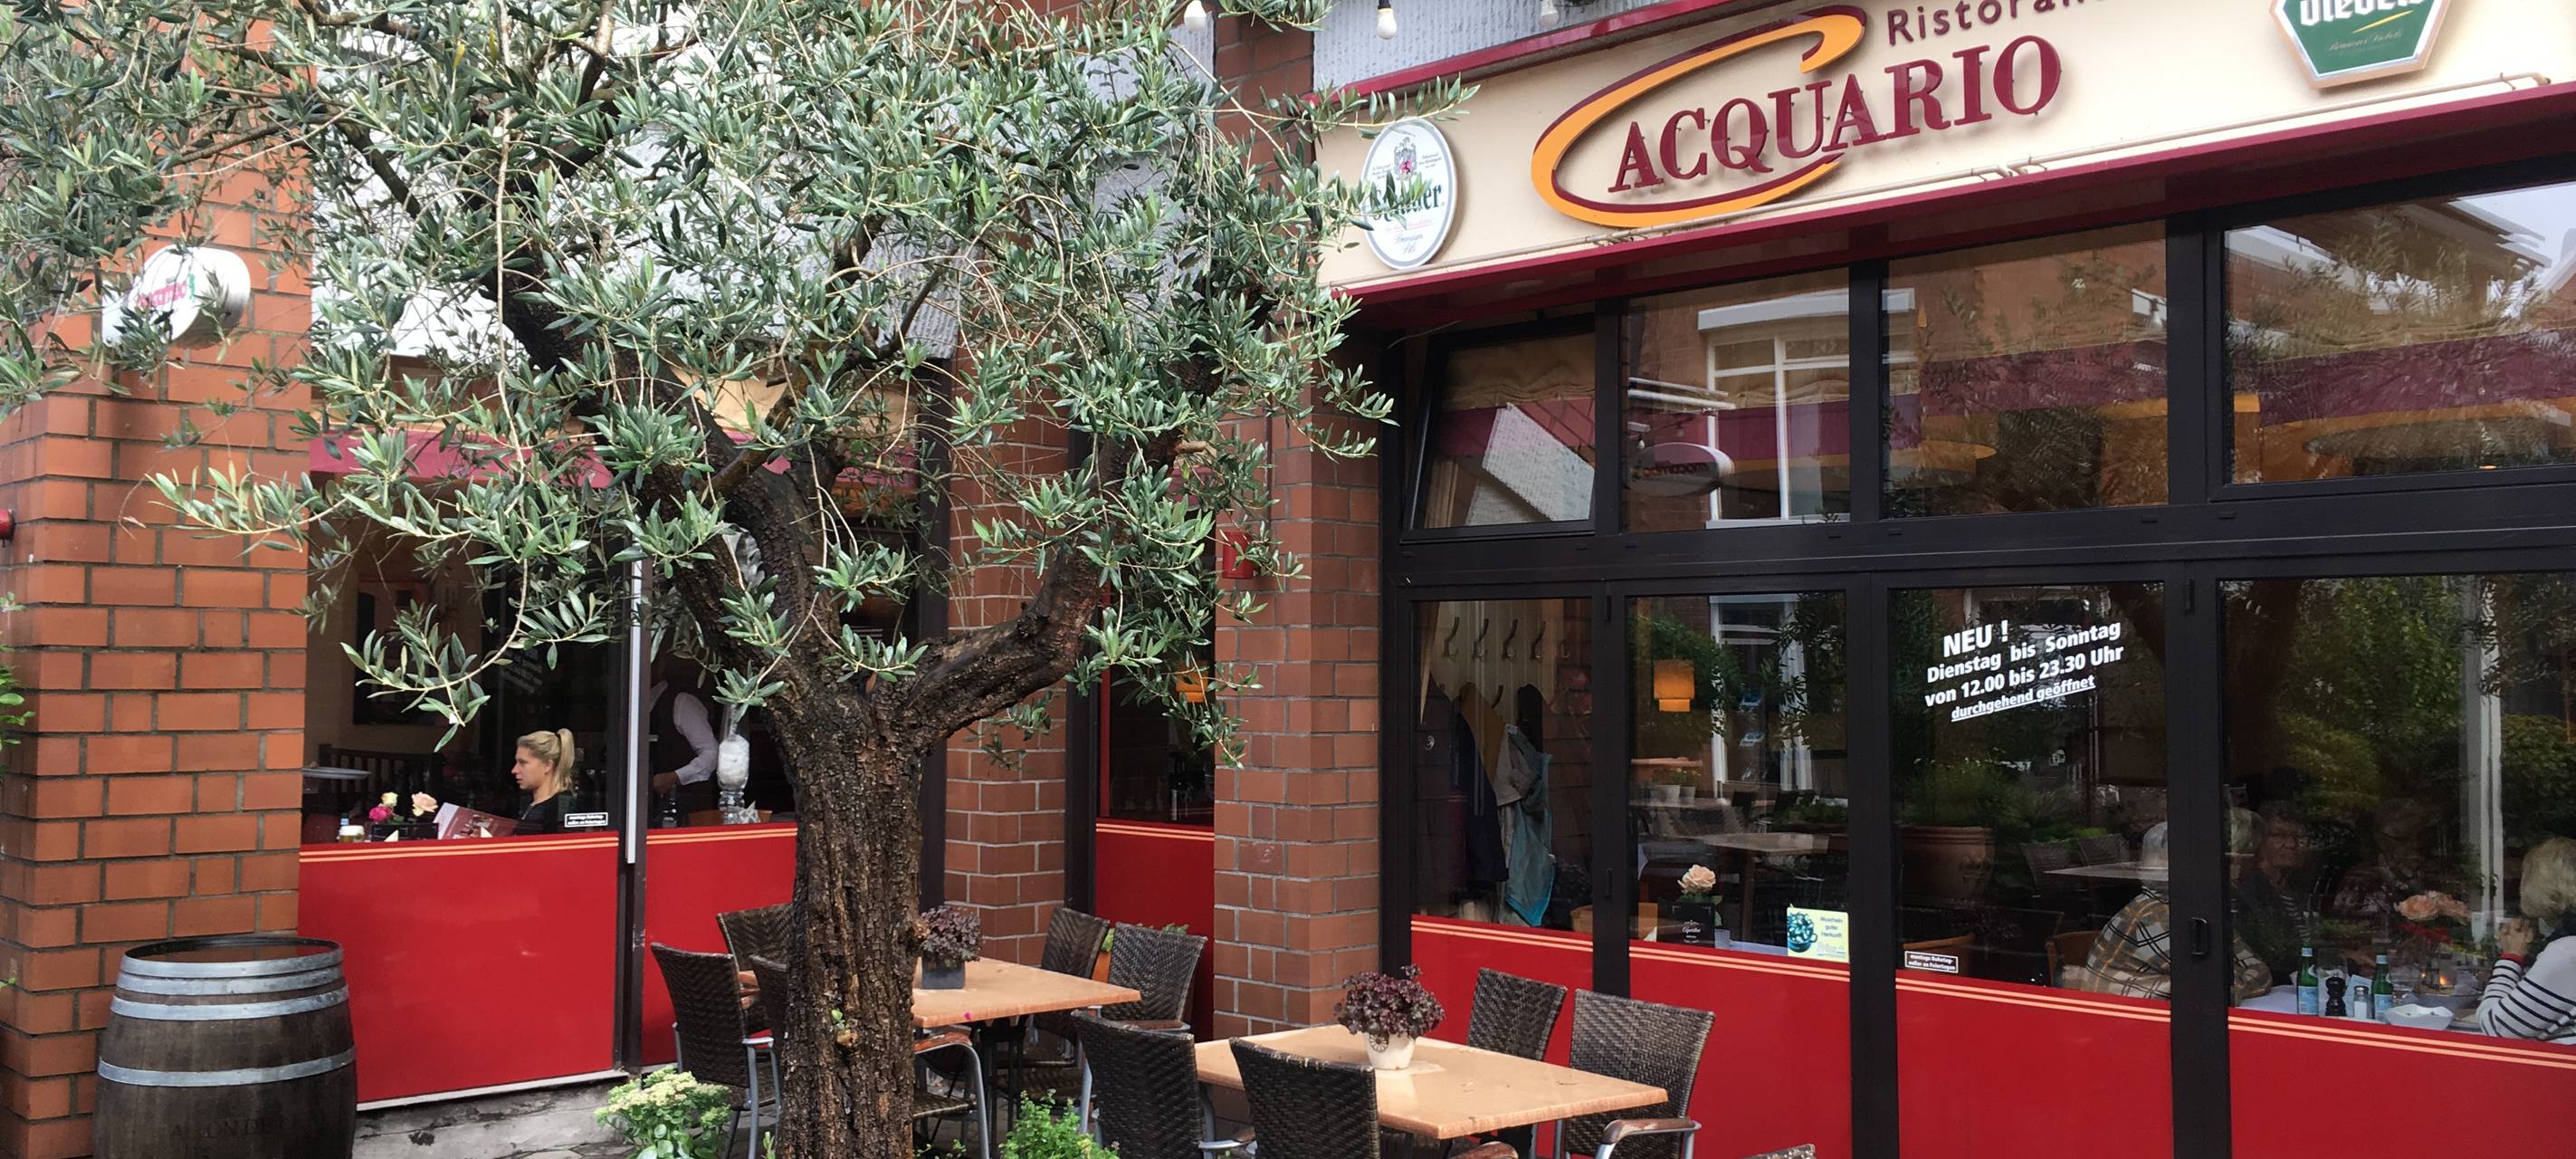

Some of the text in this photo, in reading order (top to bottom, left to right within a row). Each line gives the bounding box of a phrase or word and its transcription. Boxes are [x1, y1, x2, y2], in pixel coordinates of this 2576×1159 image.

[1608, 35, 2062, 193] ACQUARIO
[1927, 622, 2122, 683] Dienstag bis Sonntag
[1943, 619, 2008, 657] NEU !
[1924, 645, 2124, 707] von 12.00 bis 23.30 Uhr
[1951, 675, 2095, 721] durchgehend geöffnet
